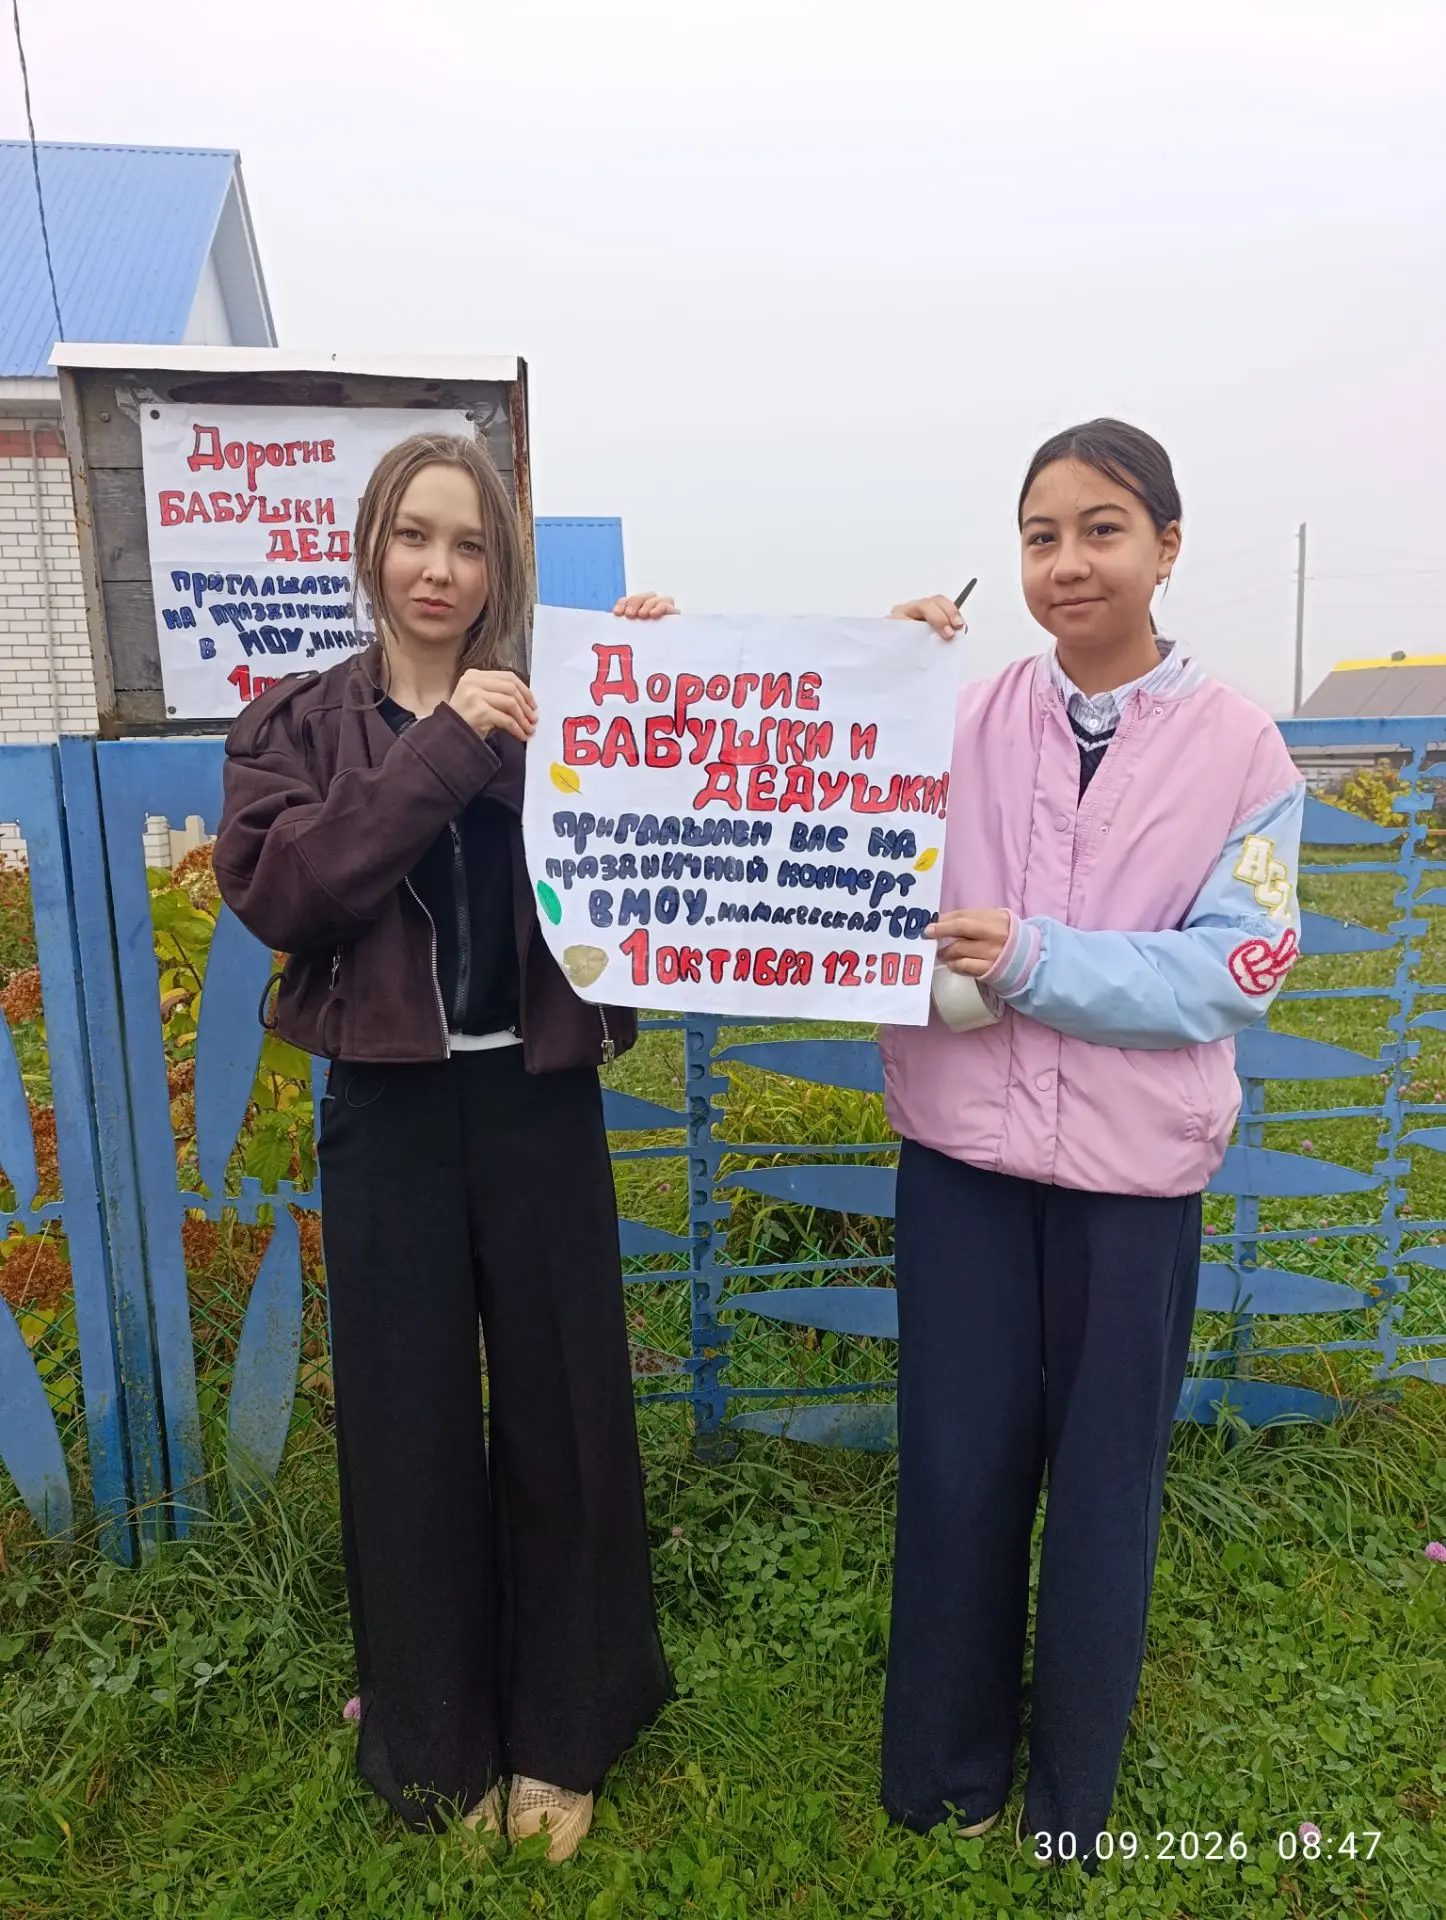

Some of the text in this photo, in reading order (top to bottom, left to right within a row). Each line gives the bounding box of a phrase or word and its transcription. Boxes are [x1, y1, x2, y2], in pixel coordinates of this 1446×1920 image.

[158, 491, 336, 526] БАБУШКИ
[266, 528, 353, 562] ДЕД
[562, 716, 834, 769] БАБУШКИ
[693, 763, 950, 819] ДЕДУШКИ!
[822, 949, 923, 987] 12:00
